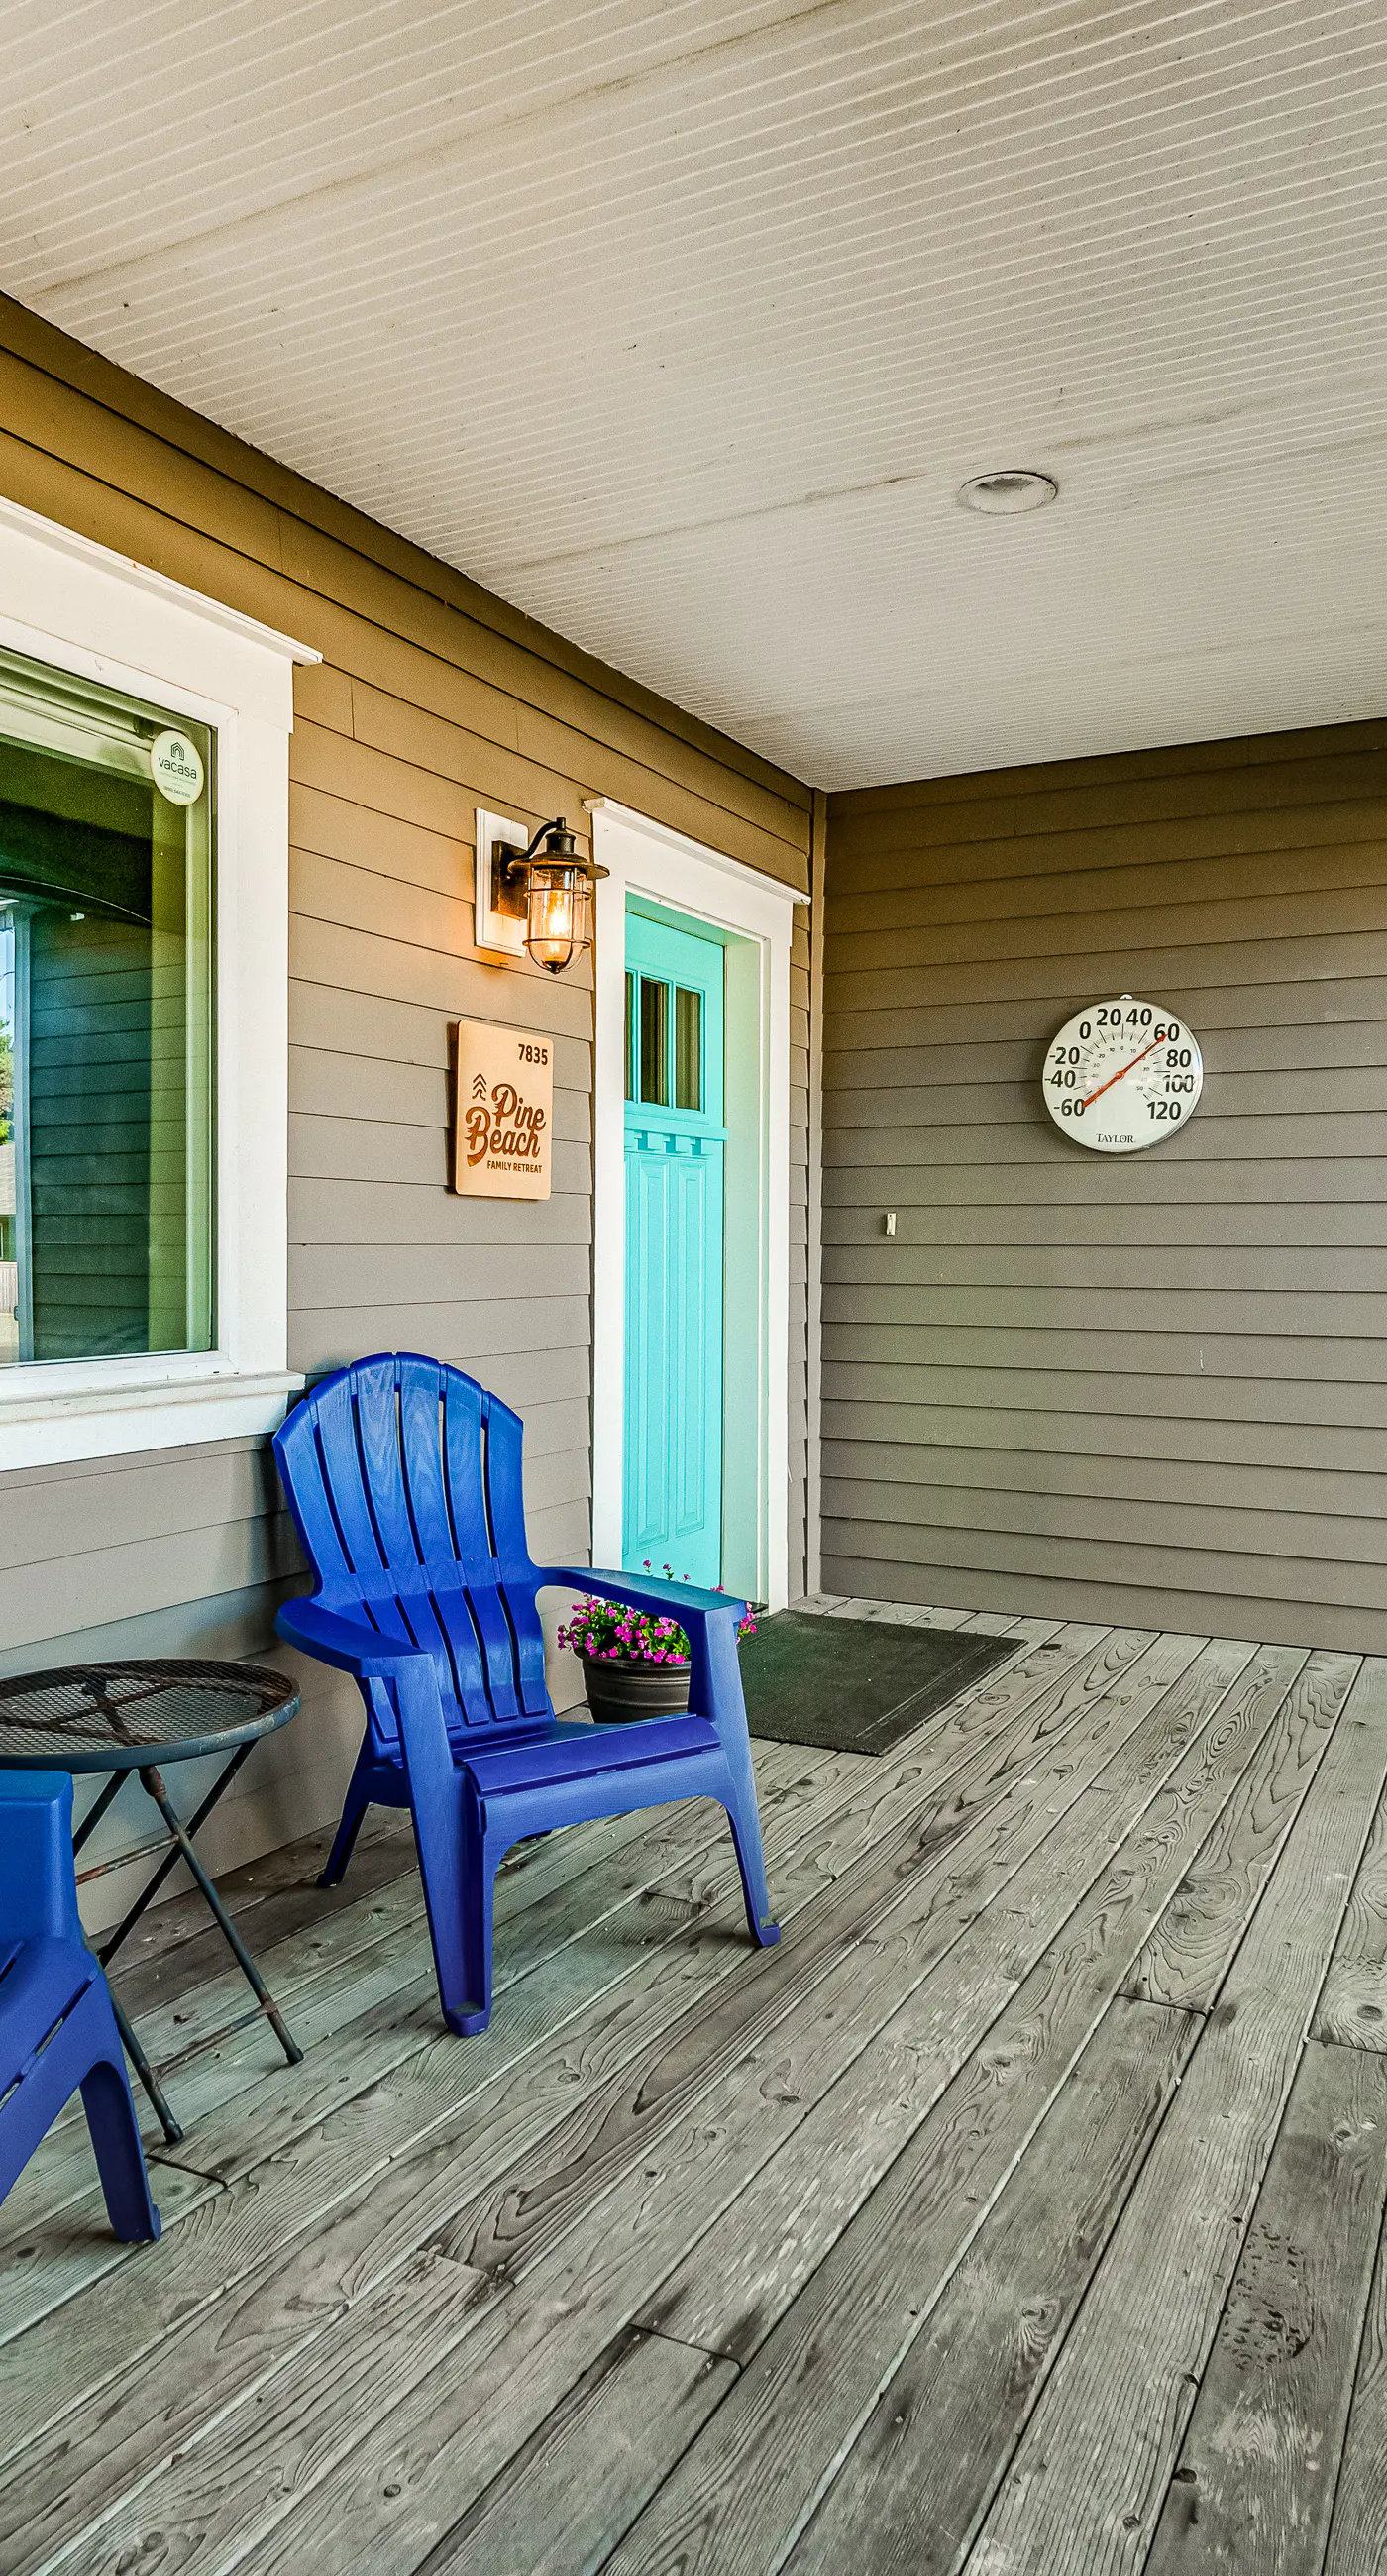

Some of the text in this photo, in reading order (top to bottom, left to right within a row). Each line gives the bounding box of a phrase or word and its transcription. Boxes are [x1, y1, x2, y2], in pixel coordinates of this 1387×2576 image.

[159, 757, 197, 780] vacasa
[1096, 1008, 1121, 1026] 20
[1125, 1008, 1152, 1026] 40
[1079, 1021, 1092, 1040] 0
[1153, 1023, 1180, 1042] 60
[518, 1043, 549, 1066] 7835
[1049, 1046, 1080, 1065] -20
[1166, 1049, 1192, 1068] 80
[1044, 1070, 1076, 1089] -40
[1163, 1074, 1195, 1093] 100
[491, 1083, 547, 1131] Pine
[1053, 1098, 1085, 1117] -60
[1146, 1101, 1182, 1120] 120
[465, 1106, 541, 1168] Beach
[487, 1160, 543, 1174] FAMILY RETREAT
